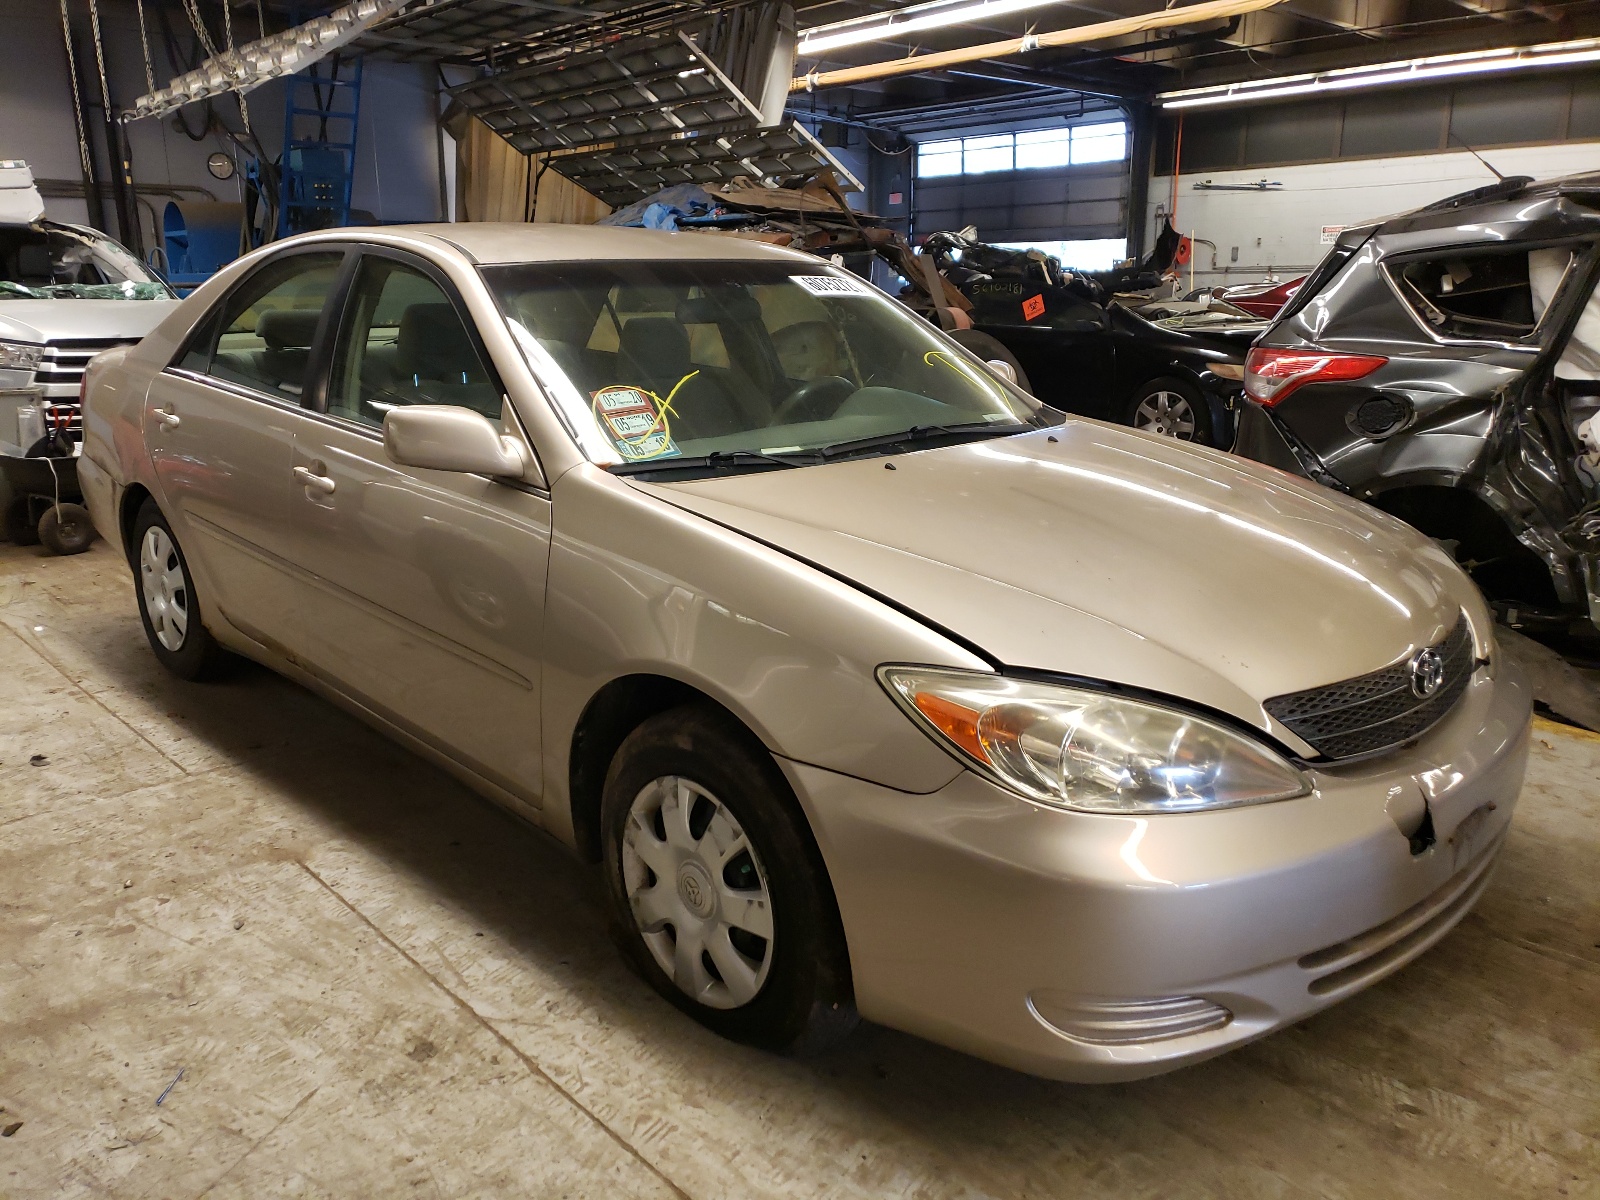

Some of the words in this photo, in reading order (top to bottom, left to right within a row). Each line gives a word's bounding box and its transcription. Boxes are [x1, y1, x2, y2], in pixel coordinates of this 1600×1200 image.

[602, 392, 616, 407] 05
[629, 390, 643, 404] 20
[614, 416, 630, 432] 05
